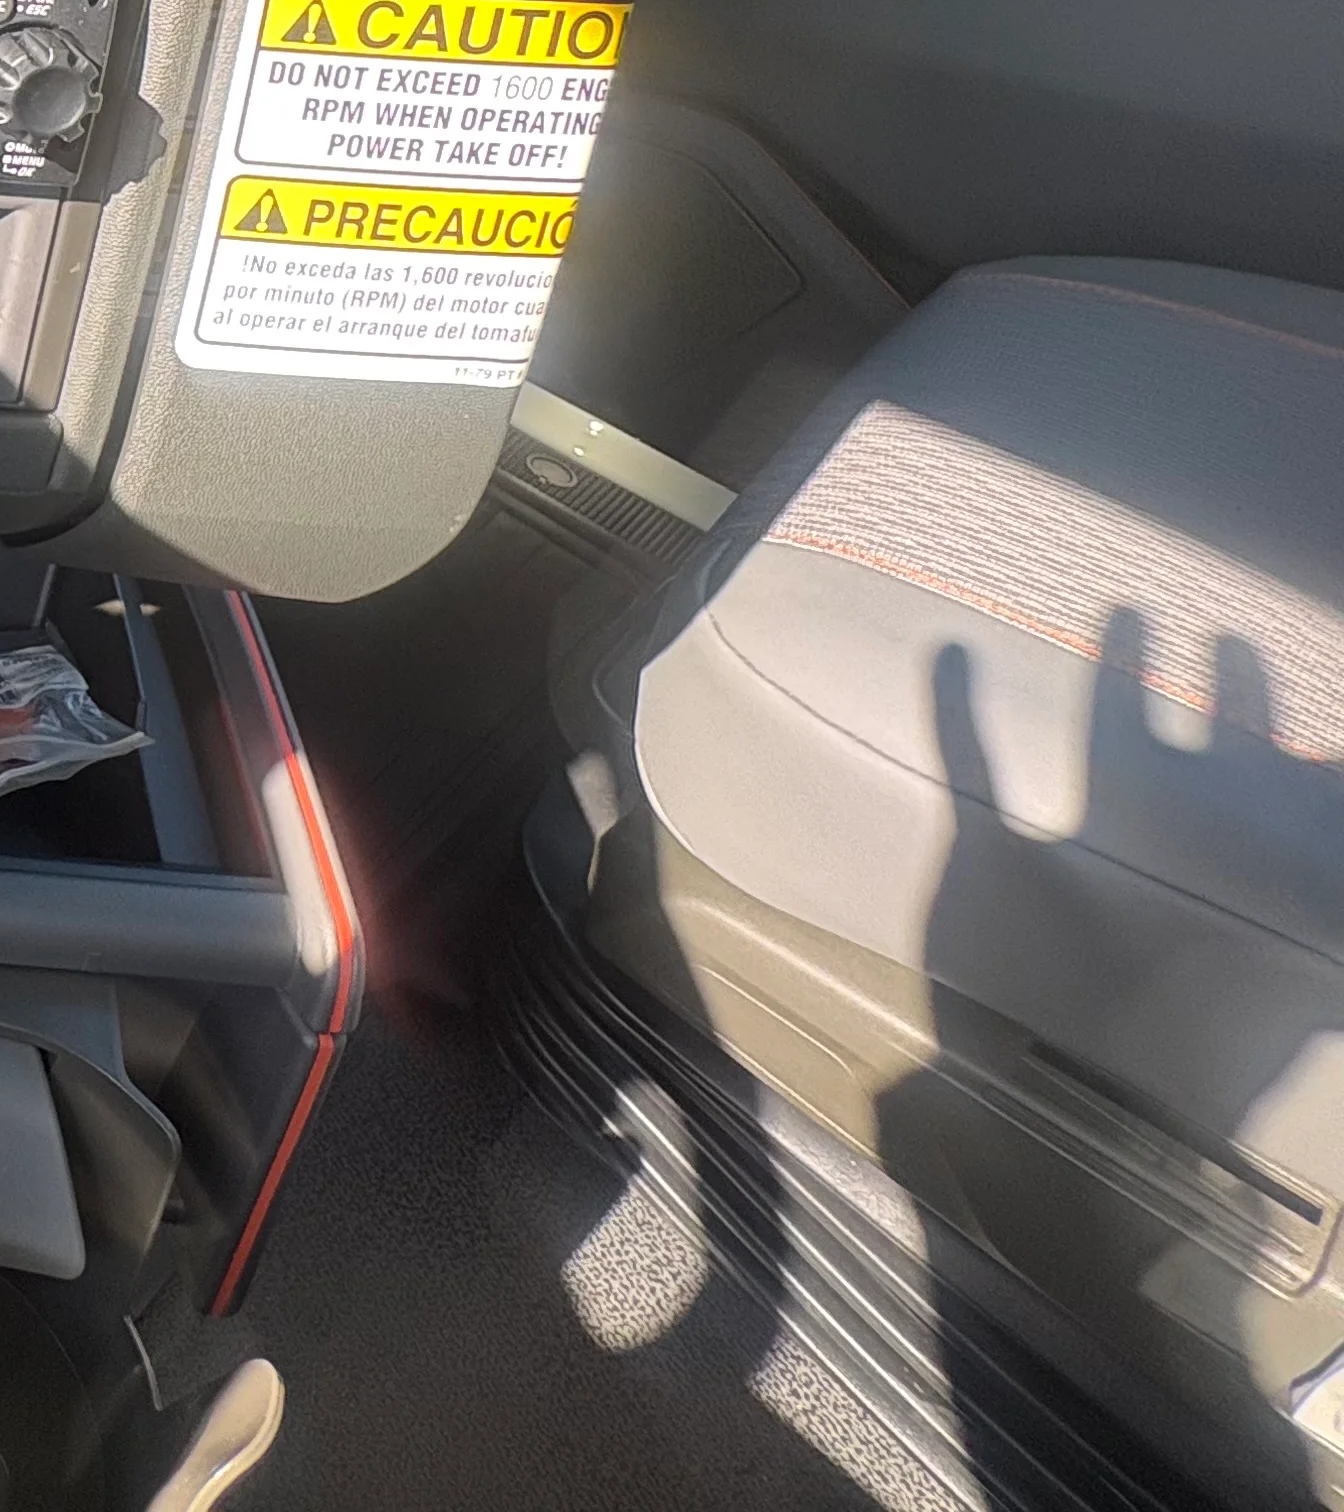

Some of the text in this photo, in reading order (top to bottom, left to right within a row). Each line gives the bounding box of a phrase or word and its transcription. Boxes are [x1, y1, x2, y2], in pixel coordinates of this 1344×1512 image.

[25, 4, 51, 16] ESC
[268, 60, 306, 86] DO
[314, 64, 369, 90] NOT
[376, 68, 481, 96] EXCEED
[492, 75, 554, 100] 1600
[302, 98, 602, 136] RPM WHEN OPERATING
[12, 155, 45, 167] MENU
[326, 134, 568, 169] POWER TAKE OFF!
[17, 167, 36, 177] OK
[285, 261, 357, 280] exceda
[364, 263, 394, 282] las
[403, 266, 458, 285] 1,600
[223, 284, 257, 301] por
[264, 285, 334, 306] minuto
[342, 289, 407, 313] (RPM)
[413, 294, 444, 312] del
[451, 297, 508, 314] motor
[213, 308, 233, 324] al
[240, 313, 306, 331] operar
[313, 316, 332, 332] el
[339, 319, 428, 340] arranque
[435, 322, 466, 339] del
